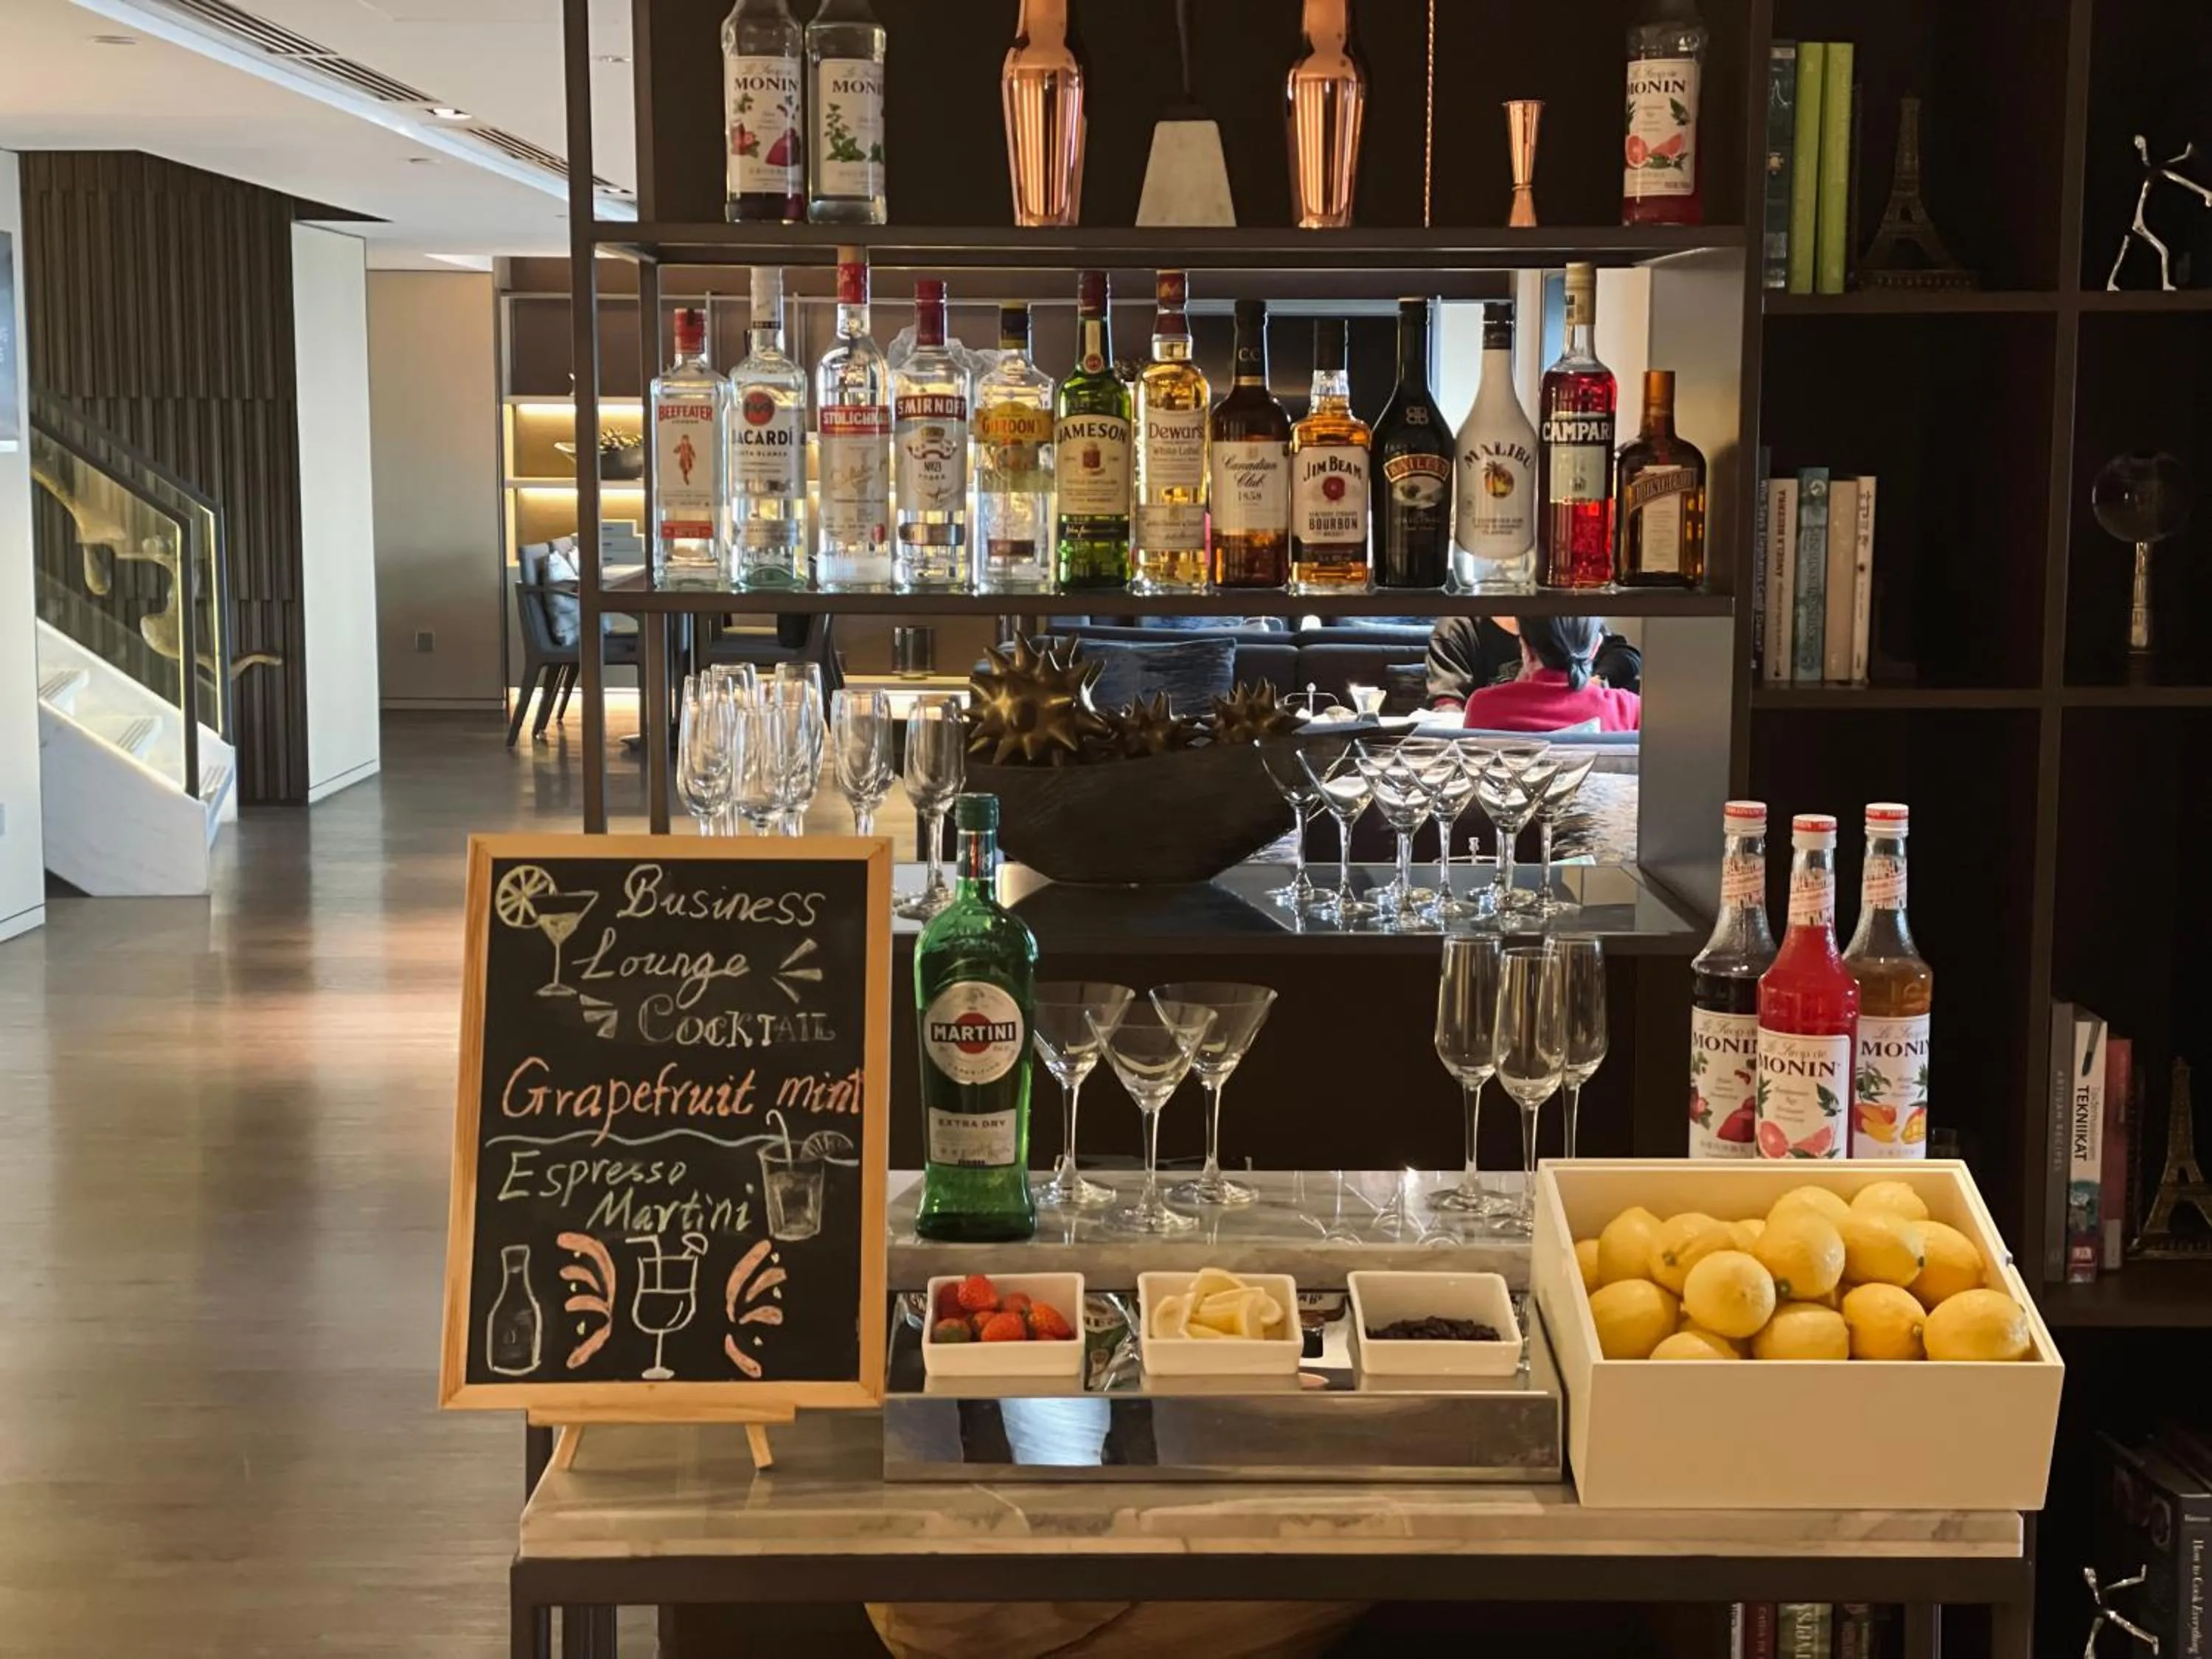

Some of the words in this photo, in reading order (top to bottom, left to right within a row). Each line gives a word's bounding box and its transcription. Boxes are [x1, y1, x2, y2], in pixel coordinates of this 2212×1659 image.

[734, 77, 799, 91] MONIN
[658, 405, 713, 422] BEEFEATER
[898, 397, 964, 415] SMIRNOFF
[1058, 422, 1127, 442] JAMESON
[1542, 421, 1613, 442] CAMPARI
[1388, 457, 1447, 476] BAILEYS
[1464, 442, 1531, 470] MALIBU
[1304, 462, 1326, 481] JIM
[1329, 456, 1362, 479] BEAM
[1309, 518, 1357, 530] BOURBON
[616, 863, 826, 927] Business
[572, 928, 751, 1009] Lounge
[934, 1024, 1013, 1041] MARTINI
[1758, 1051, 1835, 1077] MONIN
[502, 1057, 755, 1147] Grapefruit
[776, 1069, 865, 1115] mint
[939, 1119, 978, 1128] EXTRA
[982, 1119, 1005, 1128] DRY
[2074, 1085, 2090, 1161] TEKNIIKAT
[498, 1150, 687, 1207] Espresso
[586, 1183, 755, 1233] Martini
